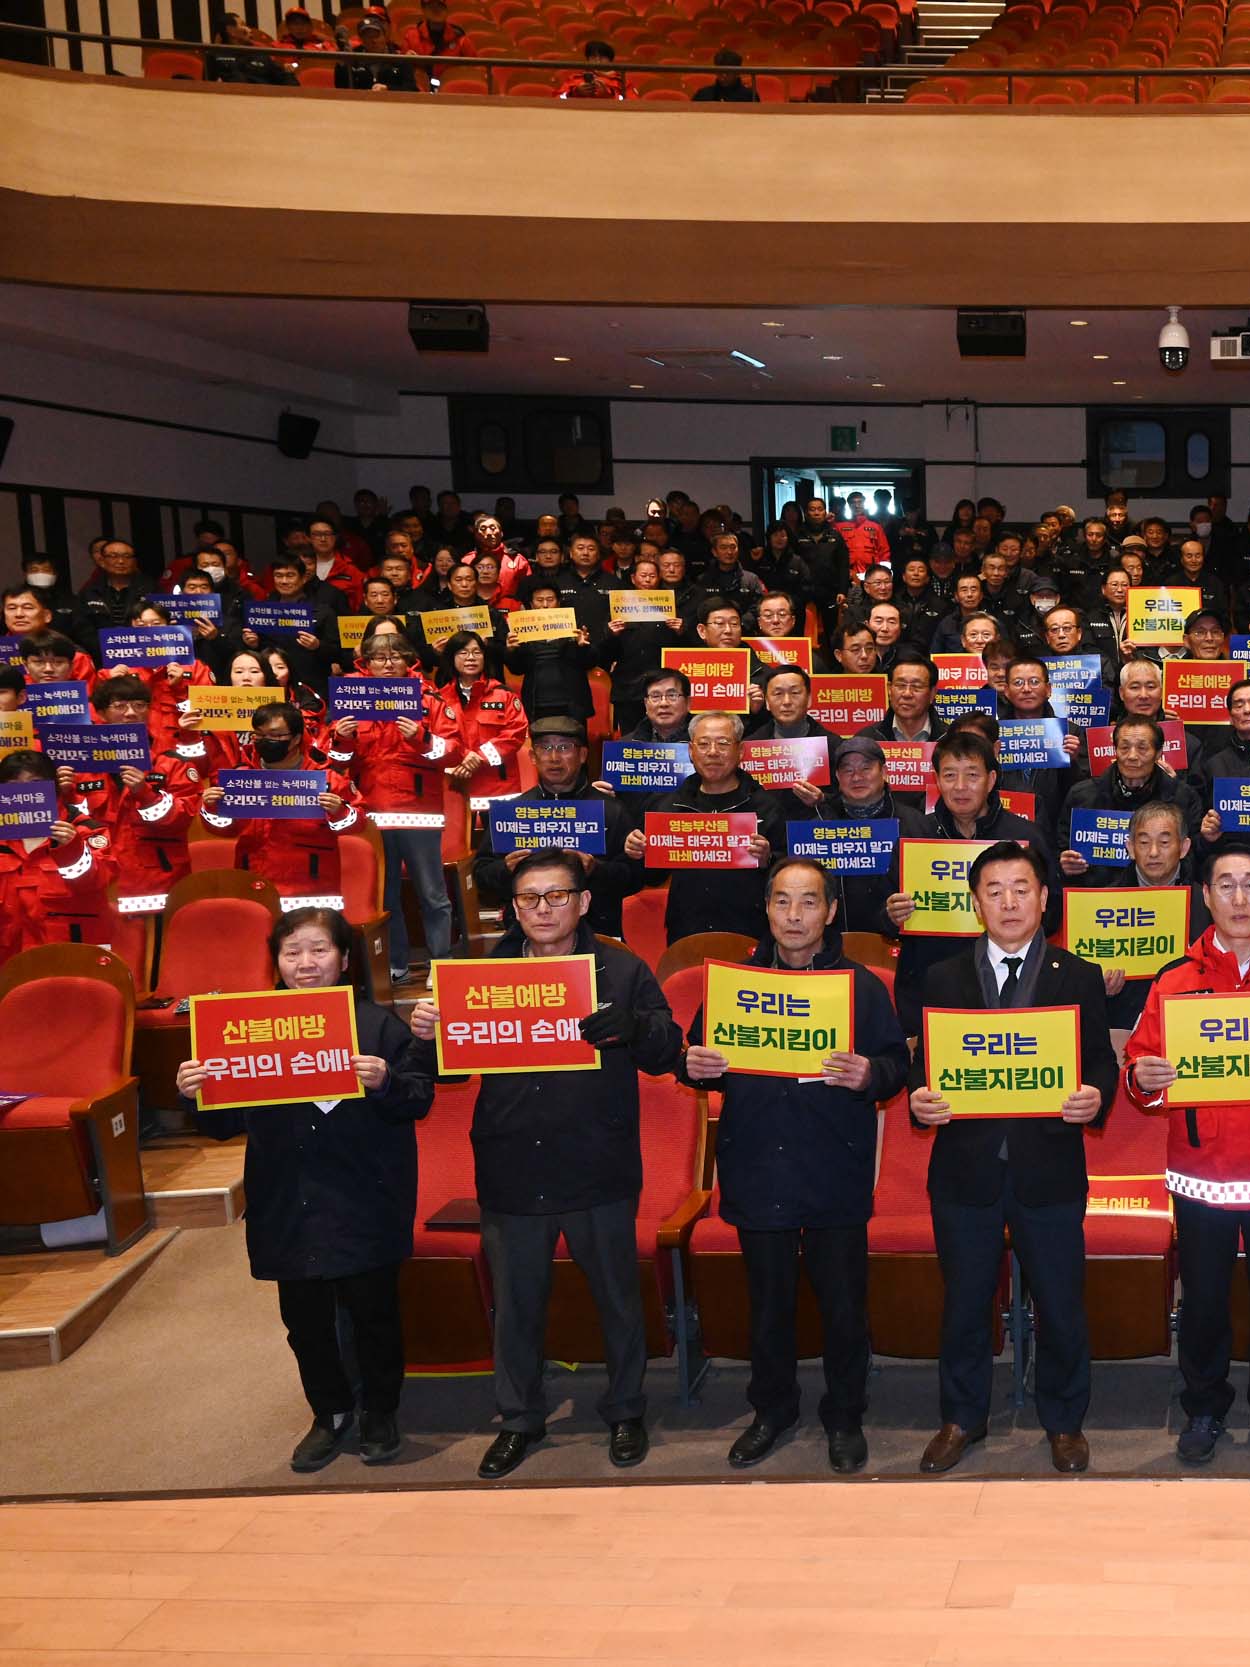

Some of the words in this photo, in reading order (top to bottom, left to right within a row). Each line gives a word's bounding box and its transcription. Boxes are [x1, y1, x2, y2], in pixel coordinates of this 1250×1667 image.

[1145, 600, 1182, 613] 우리는
[1133, 618, 1187, 631] 산불지킴
[107, 634, 136, 643] 소각산불
[153, 633, 184, 642] 녹색마을
[106, 648, 142, 658] 우리모두
[146, 646, 188, 657] 참여해요!
[679, 663, 734, 677] 산불예방
[1081, 671, 1097, 679] 말고
[1178, 675, 1231, 688] 산불예방
[44, 689, 79, 699] 녹색마을
[336, 686, 366, 694] 소각산불
[382, 685, 413, 694] 녹색마을
[712, 683, 744, 697] 손에!
[817, 689, 872, 702] 산불예방
[334, 700, 372, 710] 우리모두
[375, 699, 417, 710] 참여해요!
[1167, 694, 1207, 709] 우리의
[36, 705, 84, 716] 참여해요!
[807, 709, 848, 722] 우리의
[852, 709, 884, 722] 손에!
[1089, 707, 1105, 716] 말고
[47, 733, 80, 743] 소각산불
[101, 733, 138, 743] 녹색마을
[1009, 740, 1040, 750] 태우지
[47, 749, 89, 761] 우리모두
[93, 749, 144, 760] 참여해요!
[623, 748, 676, 759] 영농부산물
[606, 761, 635, 773] 이제는
[638, 762, 670, 773] 태우지
[226, 779, 263, 789] 소각산불
[265, 781, 280, 789] 없는
[282, 779, 317, 790] 녹색마을
[621, 774, 677, 786] 파쇄하세요!
[223, 795, 268, 807] 우리모두
[272, 795, 320, 806] 참여해요!
[515, 807, 577, 819] 영농부산물
[496, 821, 530, 833] 이제는
[534, 822, 570, 833] 태우지
[575, 822, 598, 833] 말고
[669, 820, 728, 832] 영농부산물
[1096, 816, 1130, 829] 영농부
[813, 827, 872, 840] 영농부산물
[1076, 831, 1109, 843] 이제는
[515, 836, 579, 848] 파쇄하세요!
[650, 834, 685, 847] 이제는
[687, 834, 723, 847] 태우지
[727, 835, 751, 847] 말고
[794, 842, 829, 855] 이제는
[832, 842, 867, 854] 태우지
[870, 841, 893, 853] 말고
[668, 850, 731, 862] 파쇄하세요!
[930, 859, 971, 882] 우리
[913, 890, 976, 913] 산불지
[1094, 907, 1157, 929] 우리는
[1074, 933, 1175, 959] 산불지킴이
[464, 982, 567, 1011] 산불예방
[736, 989, 811, 1017] 우리는
[222, 1014, 327, 1045] 산불예방
[447, 1020, 523, 1046] 우리의
[713, 1022, 837, 1051] 산불지킴이
[962, 1032, 1037, 1057] 우리는
[203, 1053, 284, 1081] 우리의
[289, 1047, 351, 1076] 손에!
[938, 1065, 1064, 1091] 산불지킴이
